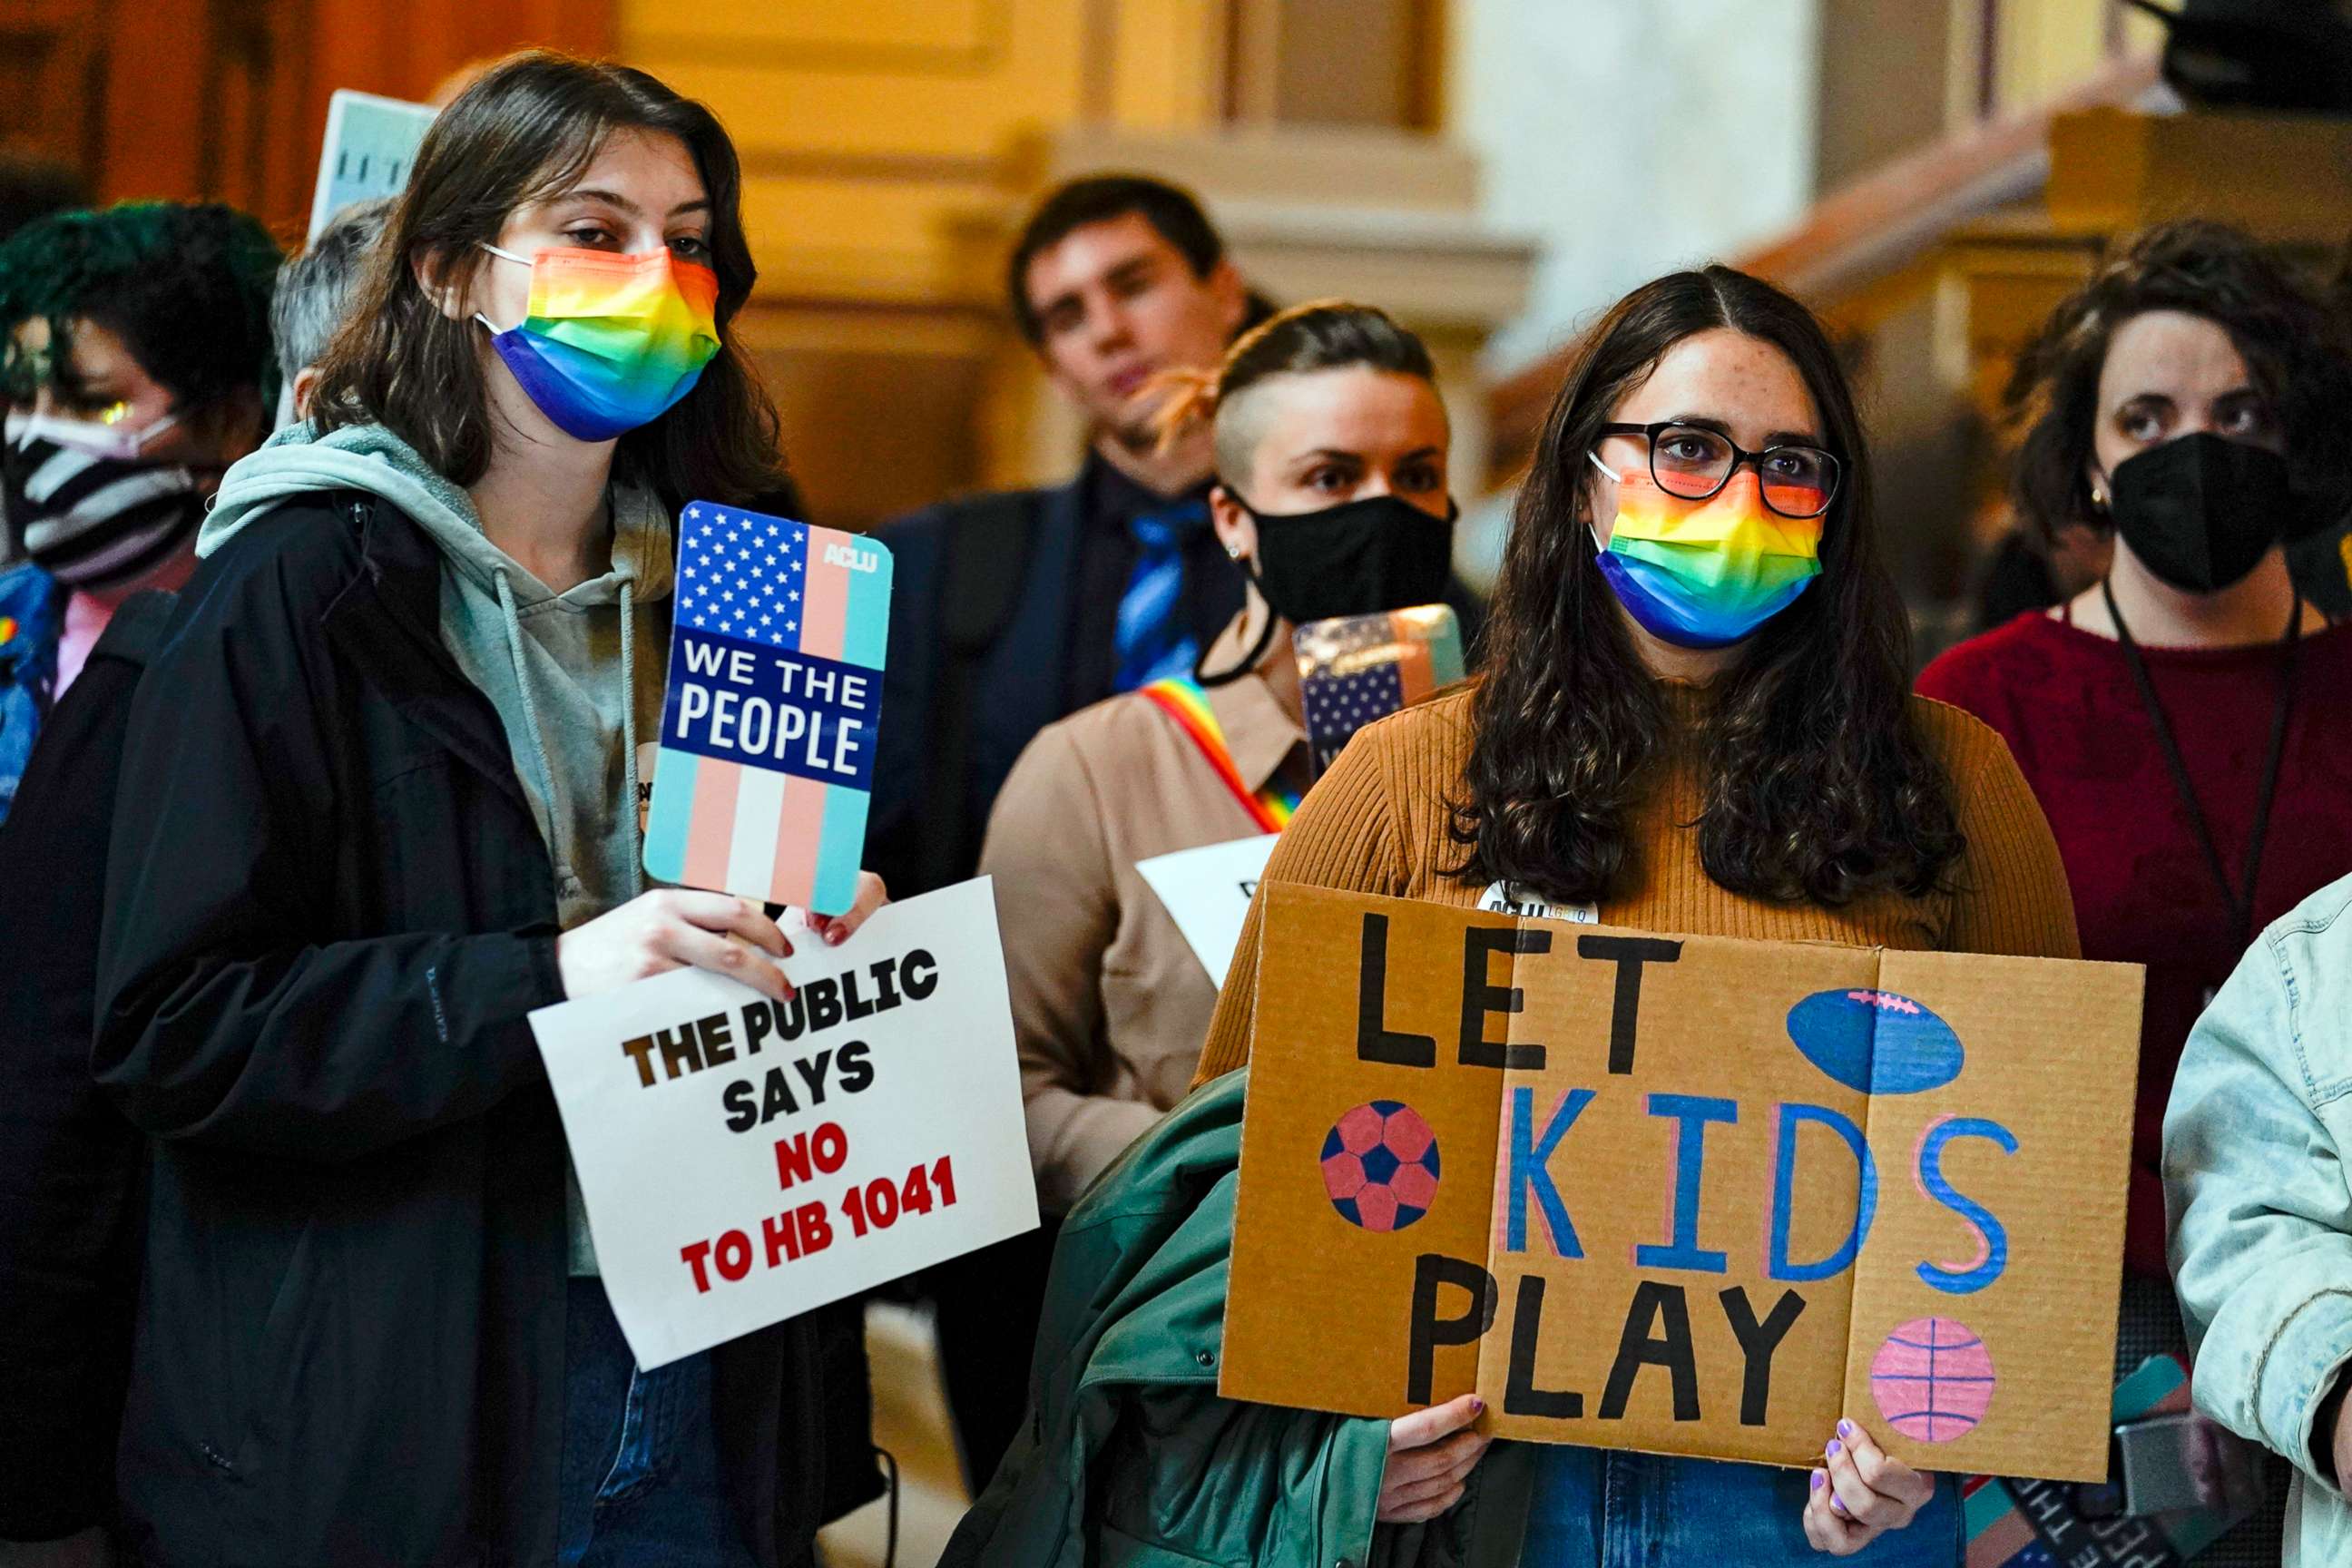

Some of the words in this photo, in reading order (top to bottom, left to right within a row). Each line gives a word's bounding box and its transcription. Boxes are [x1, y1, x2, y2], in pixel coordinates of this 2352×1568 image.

[823, 543, 877, 573] ACLU
[676, 682, 863, 776] PEOPLE
[683, 639, 756, 685] WE
[775, 660, 867, 710] THE
[622, 1012, 737, 1089] THE
[741, 948, 939, 1055] PUBLIC
[1357, 913, 1685, 1074] LET
[722, 1040, 874, 1133] SAYS
[774, 1122, 848, 1191] NO
[1495, 1088, 2020, 1296] KIDS
[681, 1230, 752, 1294] TO
[761, 1200, 833, 1269] HB
[840, 1155, 957, 1238] 1041
[1407, 1254, 1808, 1427] PLAY
